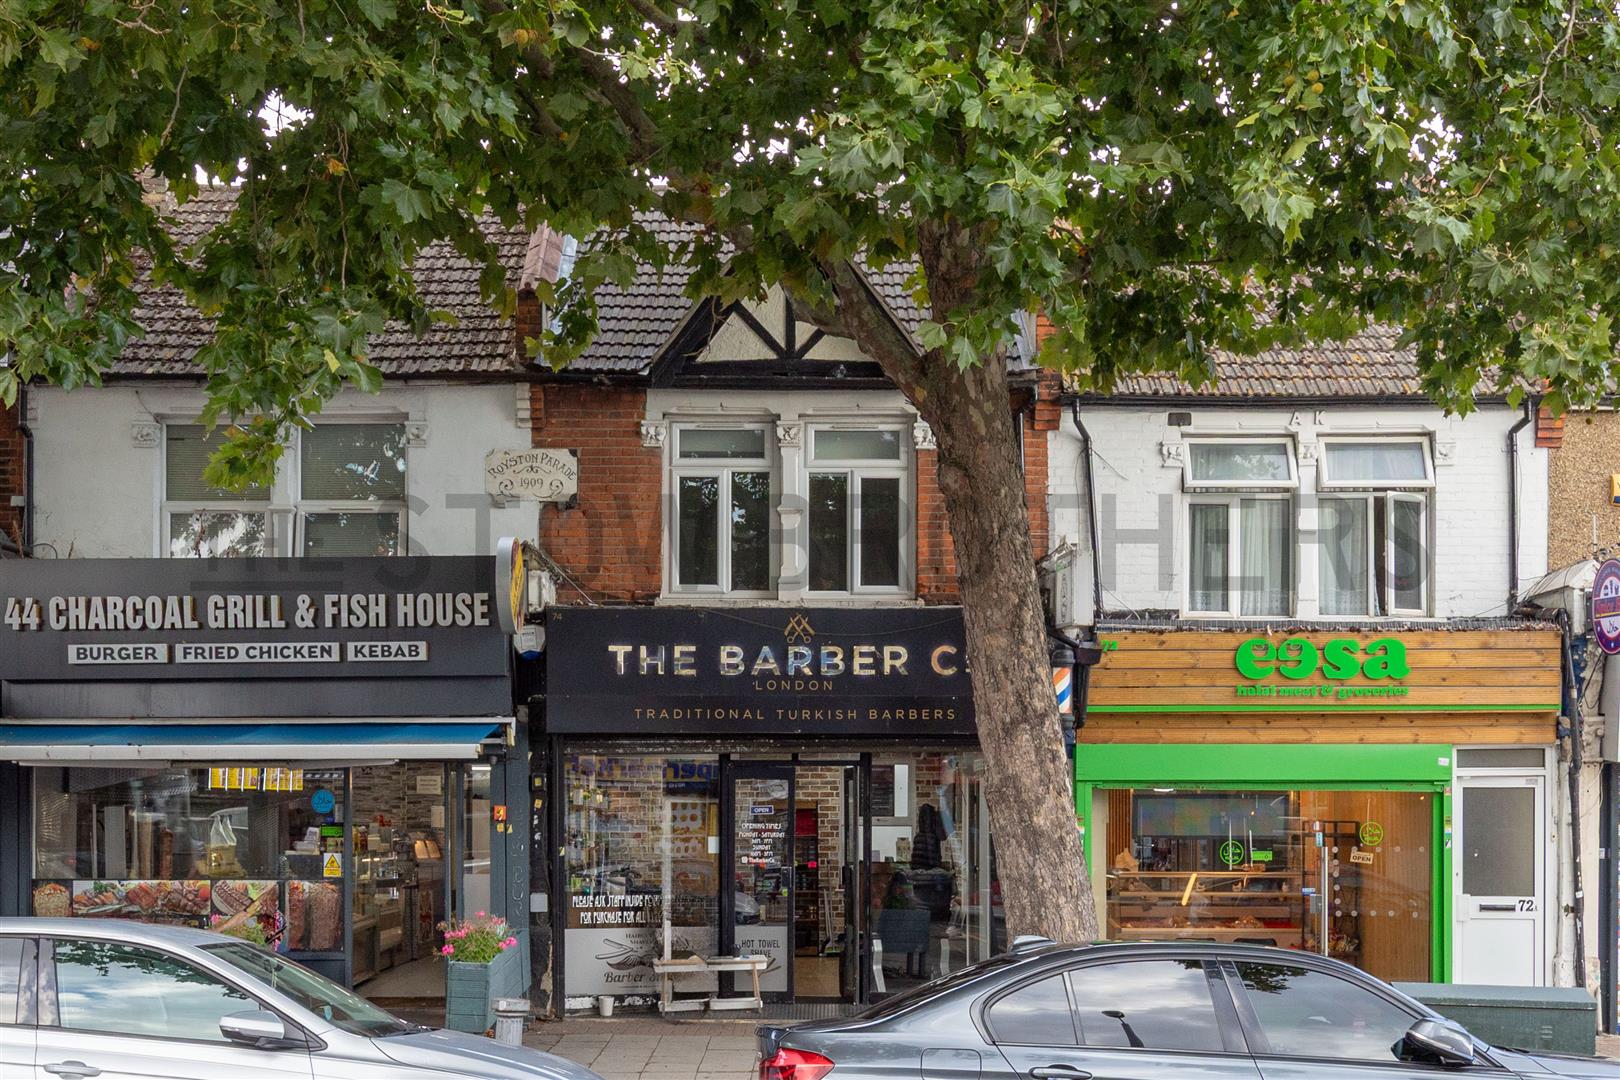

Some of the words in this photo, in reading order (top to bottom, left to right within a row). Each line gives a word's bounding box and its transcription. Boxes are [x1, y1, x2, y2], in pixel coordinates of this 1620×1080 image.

[488, 454, 538, 479] ROYSTON
[541, 452, 576, 480] PARADE
[520, 477, 543, 489] 1909
[4, 597, 41, 630] 44
[49, 595, 199, 630] CHARCOAL
[207, 594, 285, 629] GRILL
[294, 593, 317, 629] &
[324, 593, 387, 628] FISH
[396, 592, 490, 627] HOUSE
[76, 647, 158, 661] BURGER
[183, 646, 239, 660] FRIED
[245, 644, 333, 659] CHICKEN
[353, 644, 420, 658] KEBAB
[608, 645, 697, 676] THE
[720, 645, 909, 676] BARBER
[755, 680, 833, 691] LONDON
[1237, 684, 1277, 697] halal
[1279, 684, 1317, 697] meat
[1320, 684, 1334, 697] &
[1337, 685, 1409, 699] groceries
[634, 708, 765, 720] TRADITIONAL
[776, 708, 857, 720] TURKISH
[869, 708, 956, 720] BARBERS
[572, 895, 593, 908] PLEASE
[594, 895, 606, 907] ASK
[607, 895, 625, 907] STAFF
[580, 912, 592, 924] FOR
[593, 912, 622, 924] PURCHASE
[623, 911, 635, 923] FOR
[635, 911, 646, 923] ALL
[741, 939, 755, 948] HOT
[758, 939, 781, 948] TOWEL
[604, 971, 645, 983] Barber
